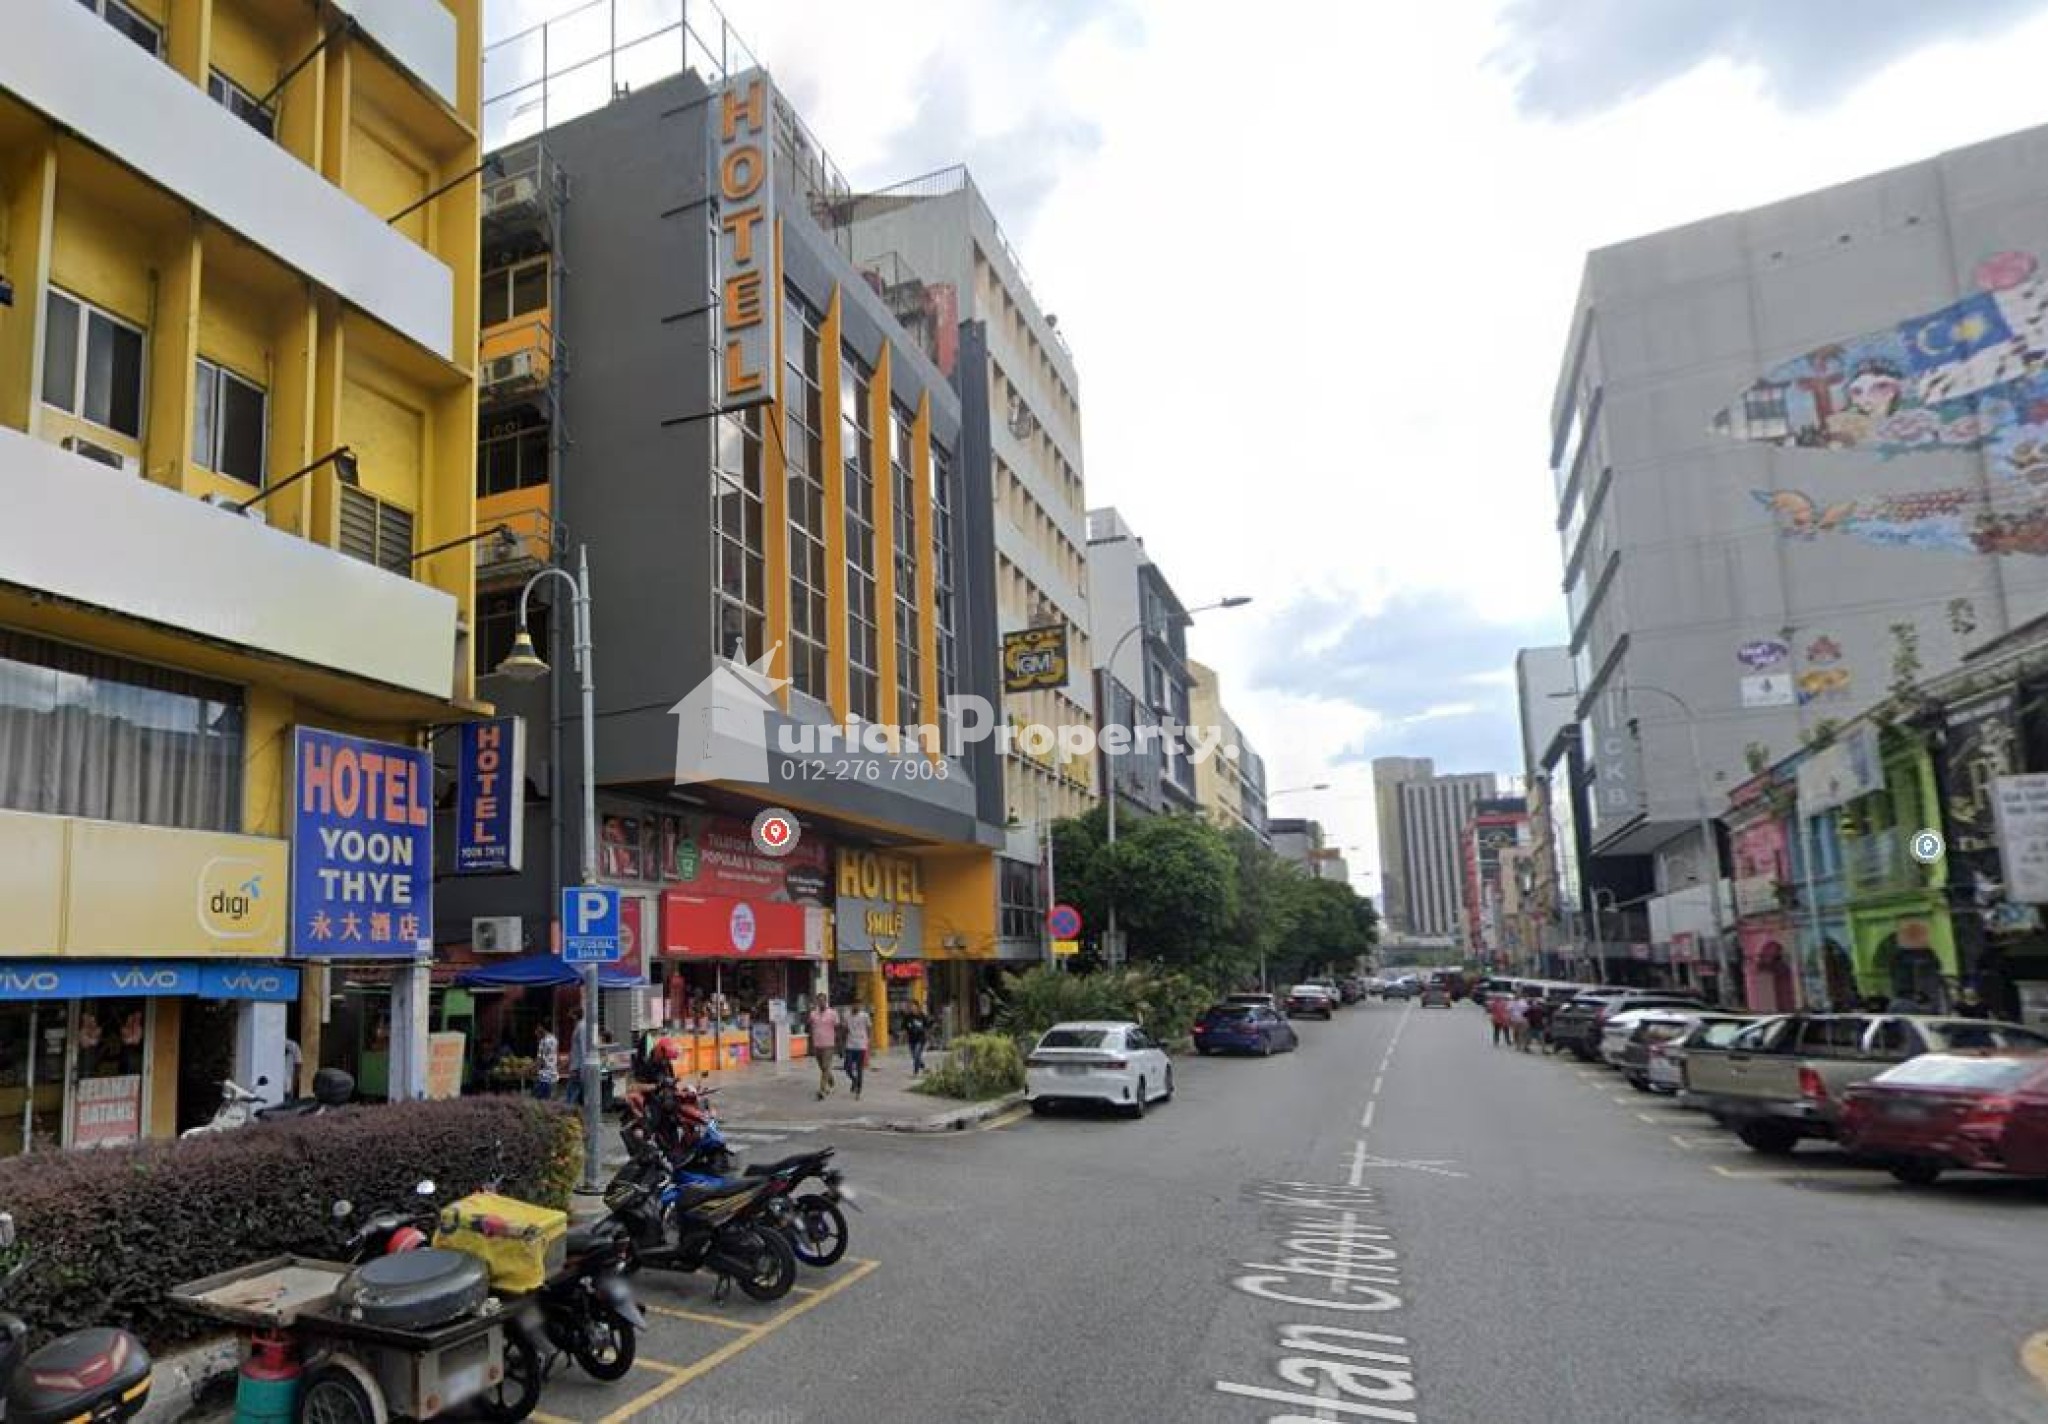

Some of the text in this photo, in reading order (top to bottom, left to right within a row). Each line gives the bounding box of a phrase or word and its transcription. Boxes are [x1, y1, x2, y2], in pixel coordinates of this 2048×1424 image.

[721, 79, 765, 396] HOTEL
[303, 740, 427, 827] HOTEL
[474, 725, 499, 843] HOTEL
[319, 828, 413, 866] YOON
[318, 869, 412, 904] THYE
[840, 849, 925, 905] HOTEL
[211, 889, 249, 921] digi
[578, 892, 609, 933] P
[309, 910, 420, 942] 永大酒店
[866, 909, 905, 937] SMILE
[0, 966, 60, 991] ivo
[111, 966, 179, 989] vivo
[221, 970, 281, 993] vivo
